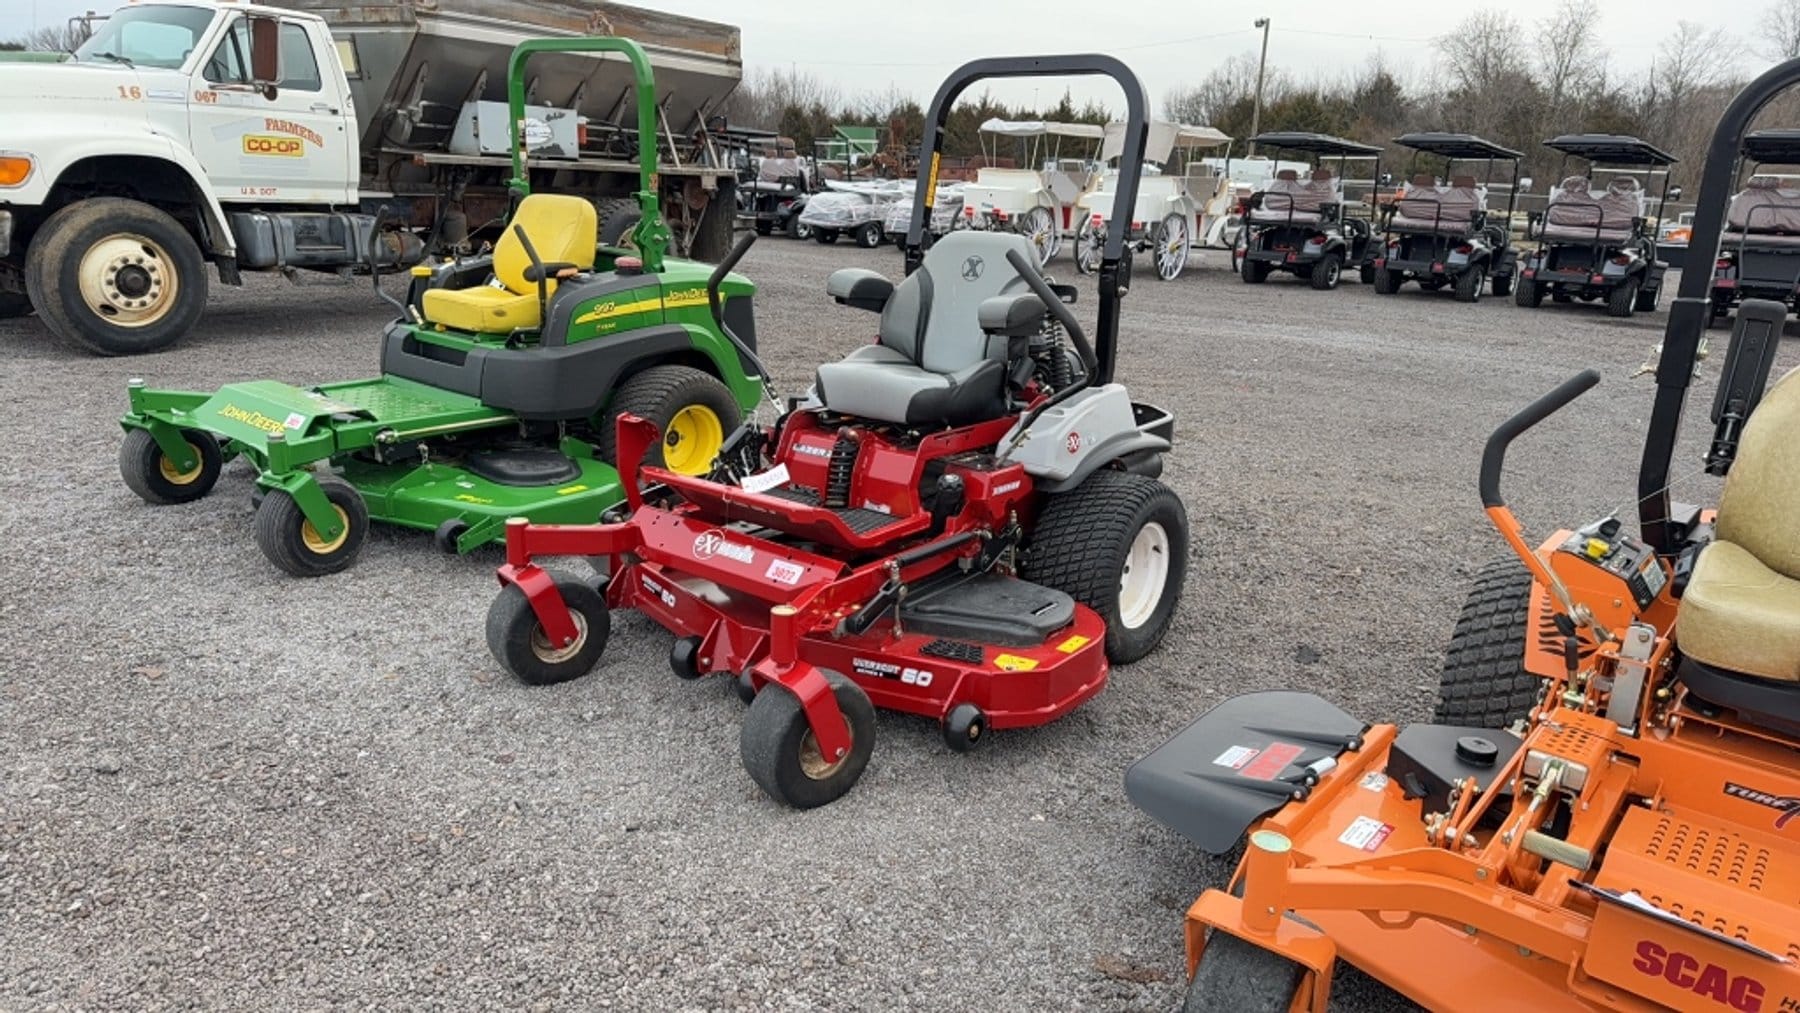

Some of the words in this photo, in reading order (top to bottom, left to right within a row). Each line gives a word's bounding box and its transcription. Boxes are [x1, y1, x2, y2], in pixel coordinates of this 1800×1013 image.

[118, 86, 142, 100] 16
[194, 91, 218, 104] 067
[264, 118, 323, 148] FARMERS
[246, 139, 300, 153] CO-OP
[260, 187, 277, 196] DOT
[217, 403, 250, 424] JOHN
[901, 668, 933, 687] 60
[1727, 784, 1790, 807] TURF
[1633, 941, 1765, 1013] SCAG
